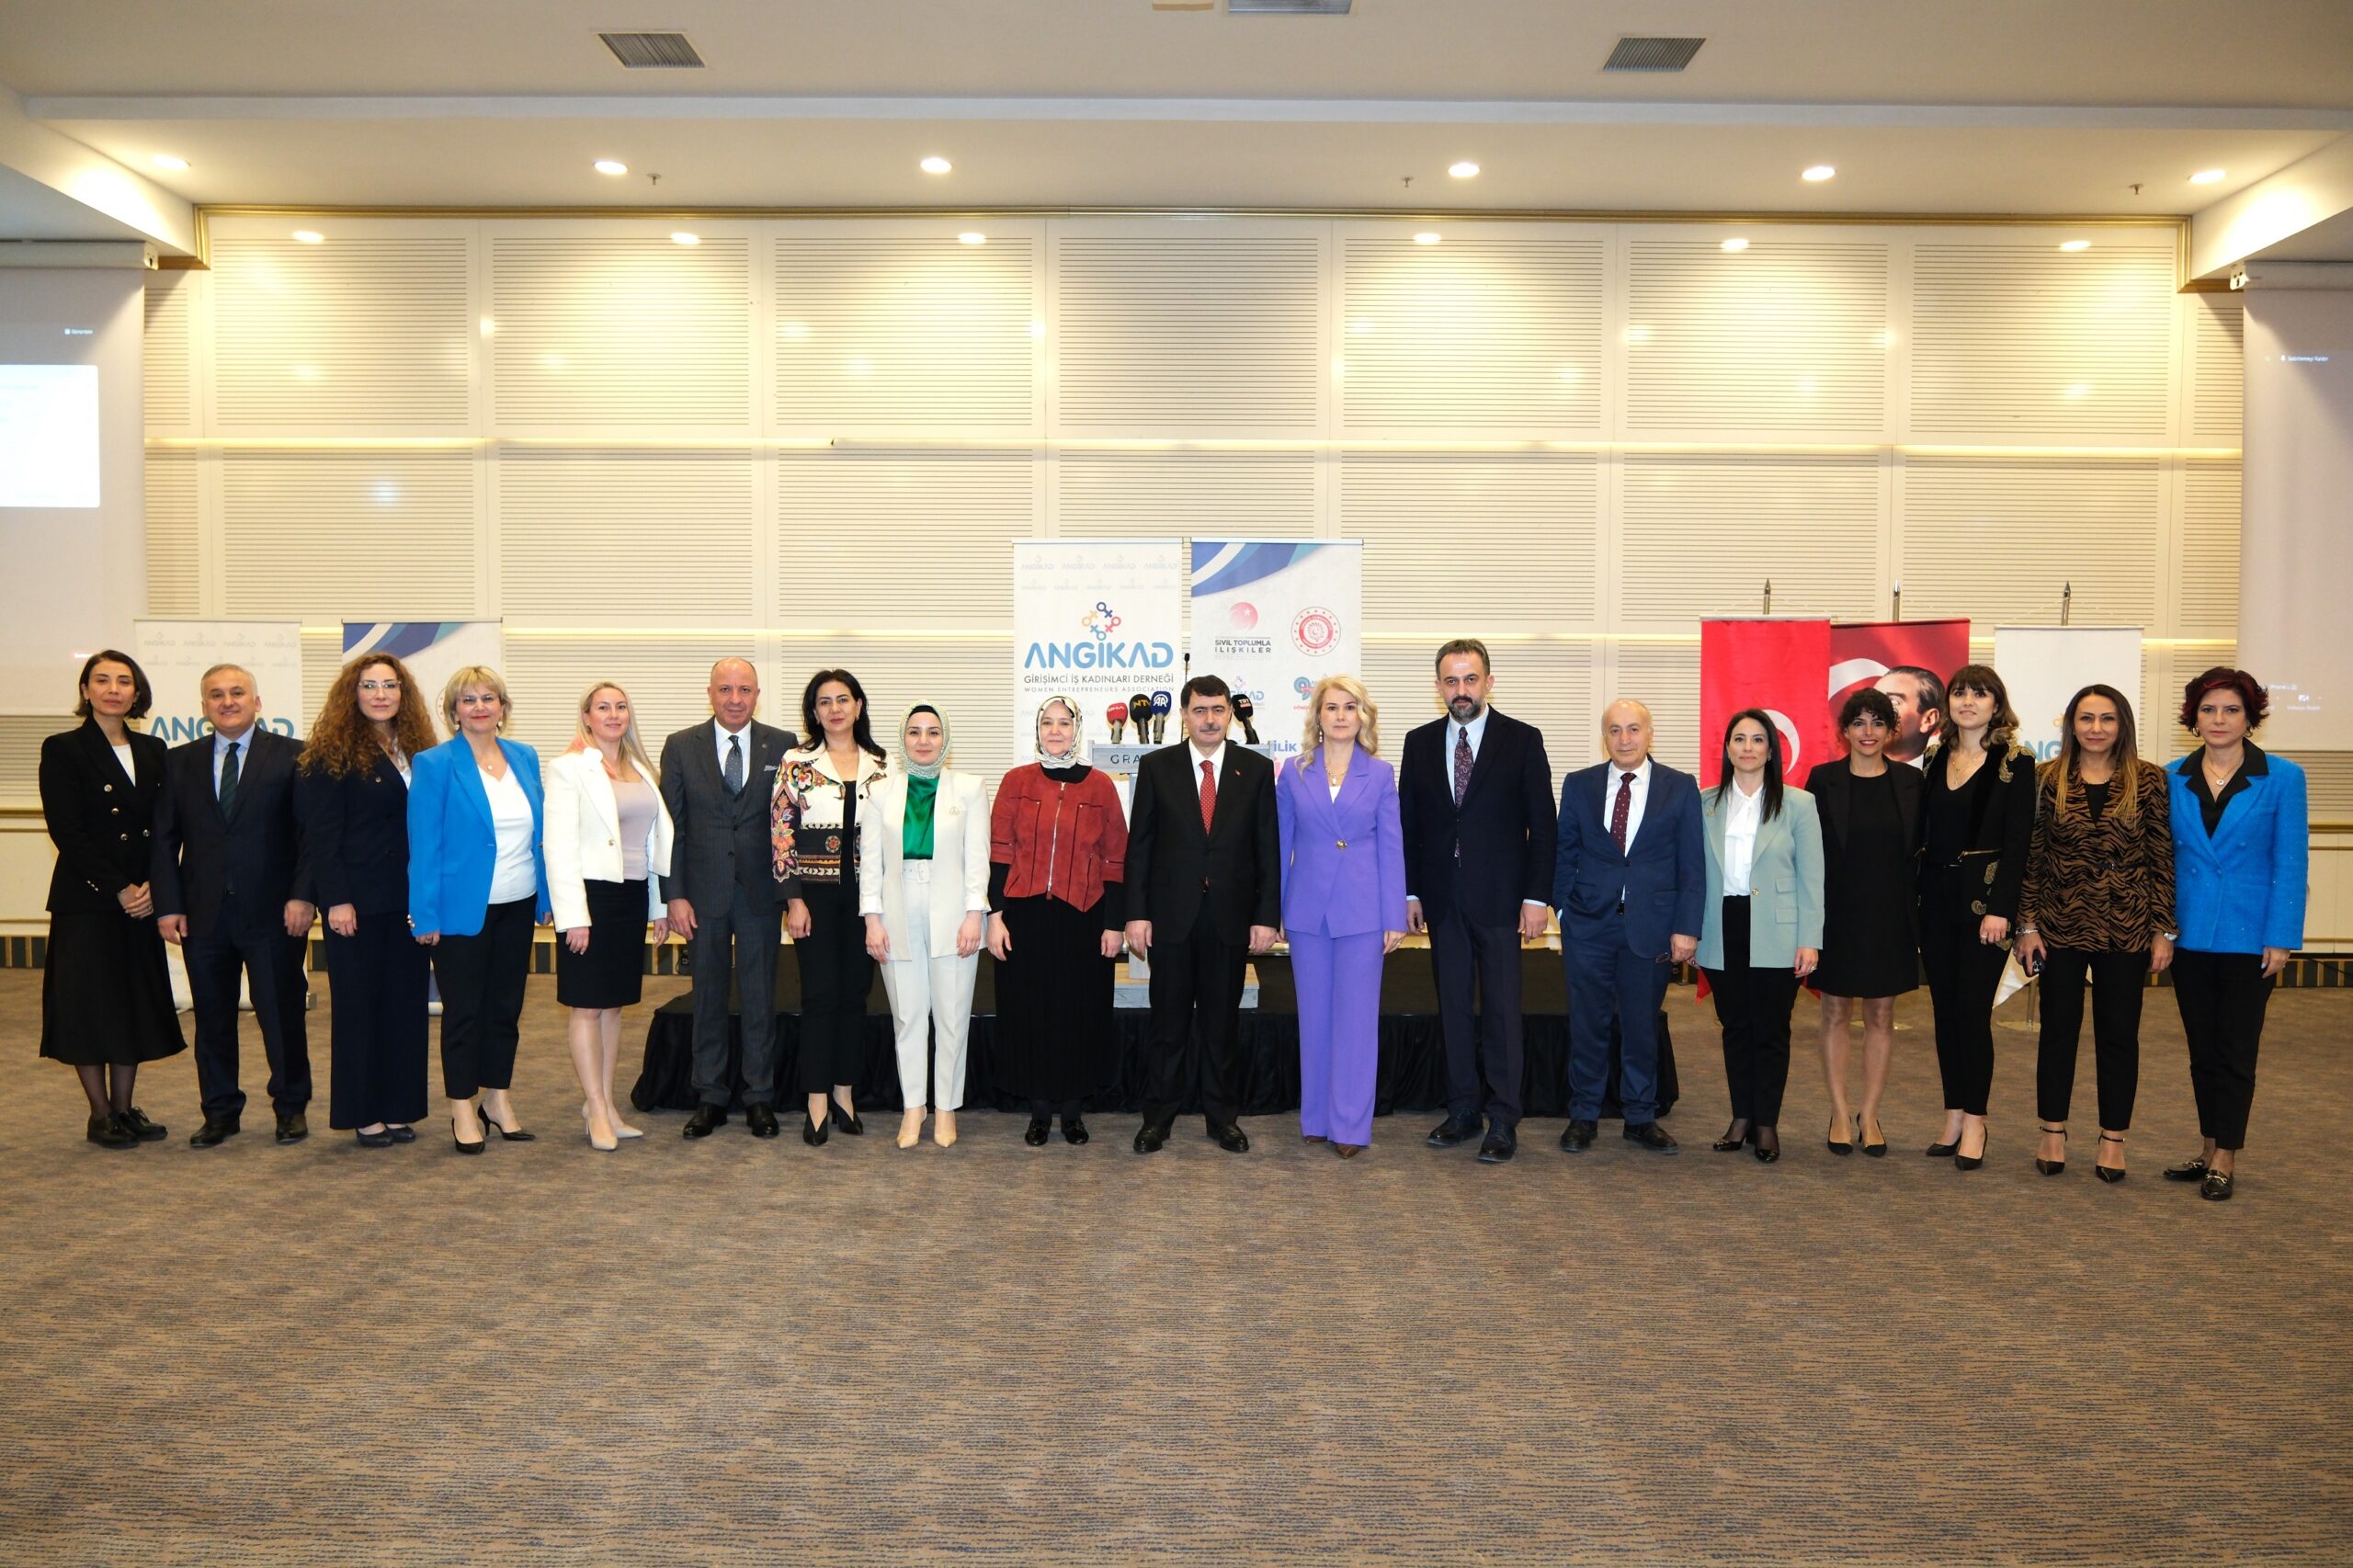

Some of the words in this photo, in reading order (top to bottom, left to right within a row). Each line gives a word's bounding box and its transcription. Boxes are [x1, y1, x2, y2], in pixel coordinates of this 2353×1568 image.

[1024, 674, 1068, 685] GİRİŞİMCİ
[1071, 674, 1079, 685] İŞ
[1082, 675, 1131, 683] KADINLARI
[1133, 673, 1174, 683] DERNEĞİ
[1110, 755, 1141, 764] GRA
